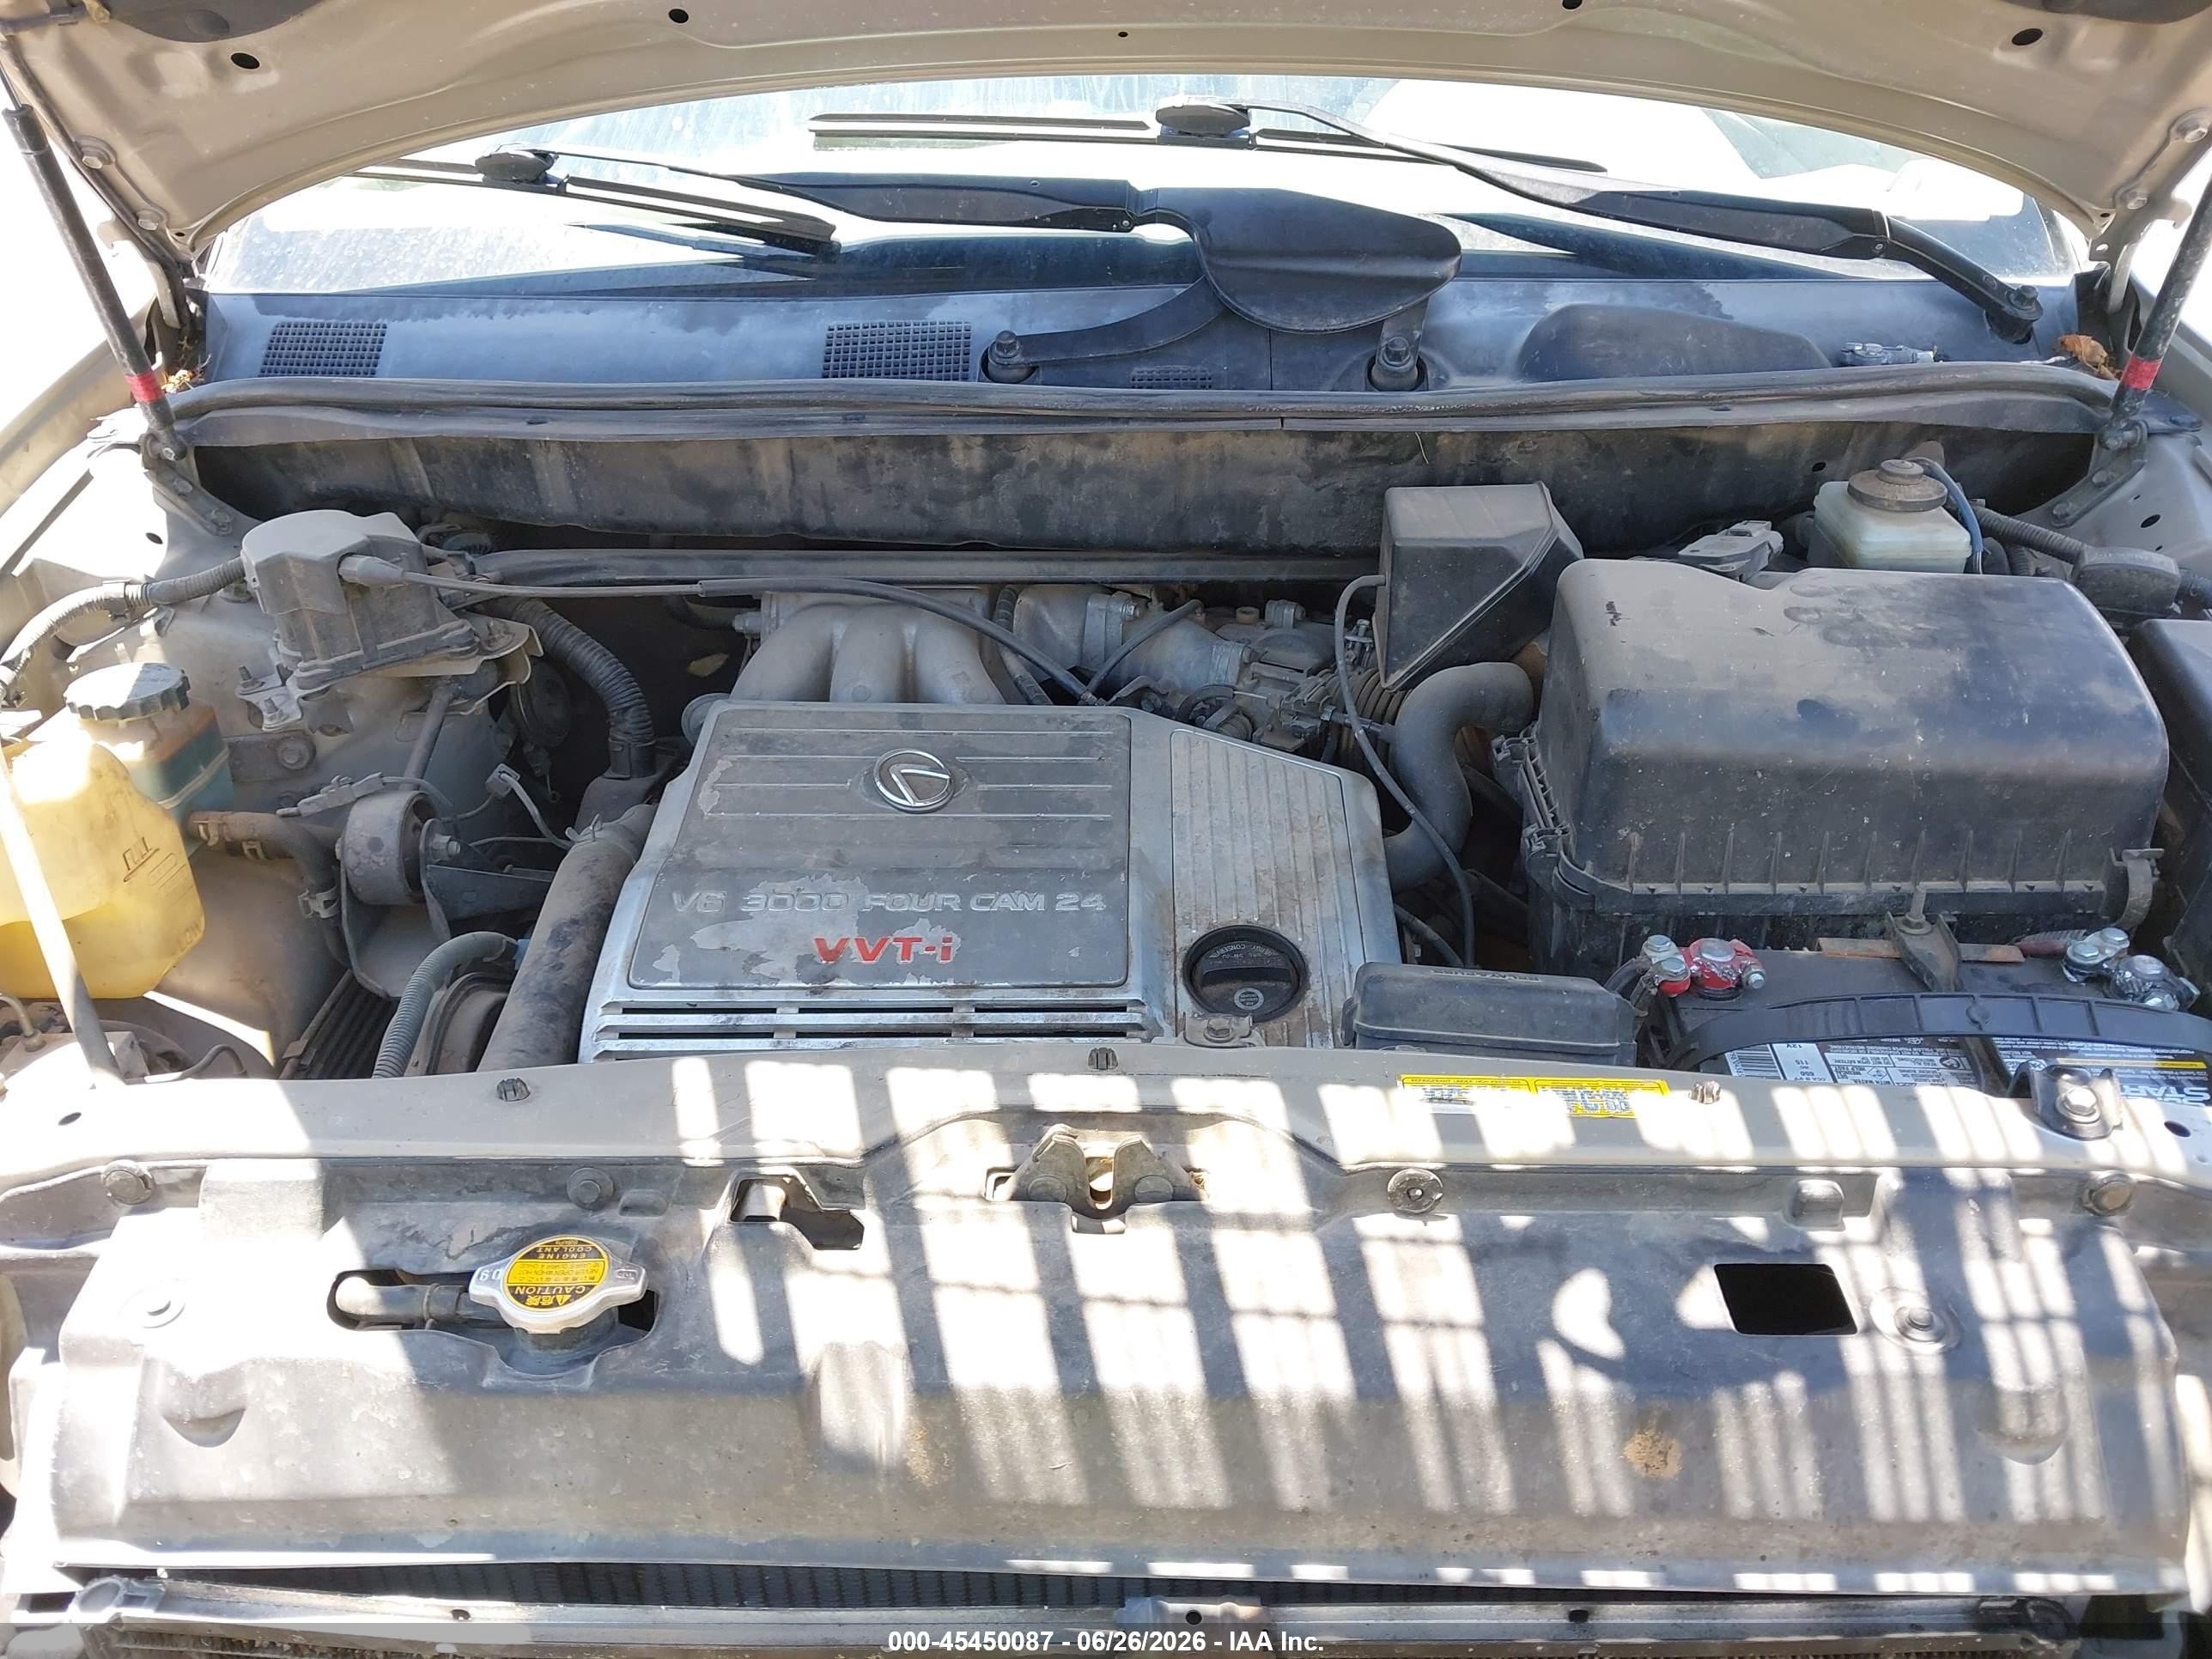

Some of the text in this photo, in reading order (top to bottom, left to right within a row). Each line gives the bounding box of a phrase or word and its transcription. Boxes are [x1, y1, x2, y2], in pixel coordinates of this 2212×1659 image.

[672, 890, 1107, 914] V6 3000 FOUR CAM 24
[812, 934, 953, 964] VVT-i
[515, 1285, 586, 1295] CAUTION
